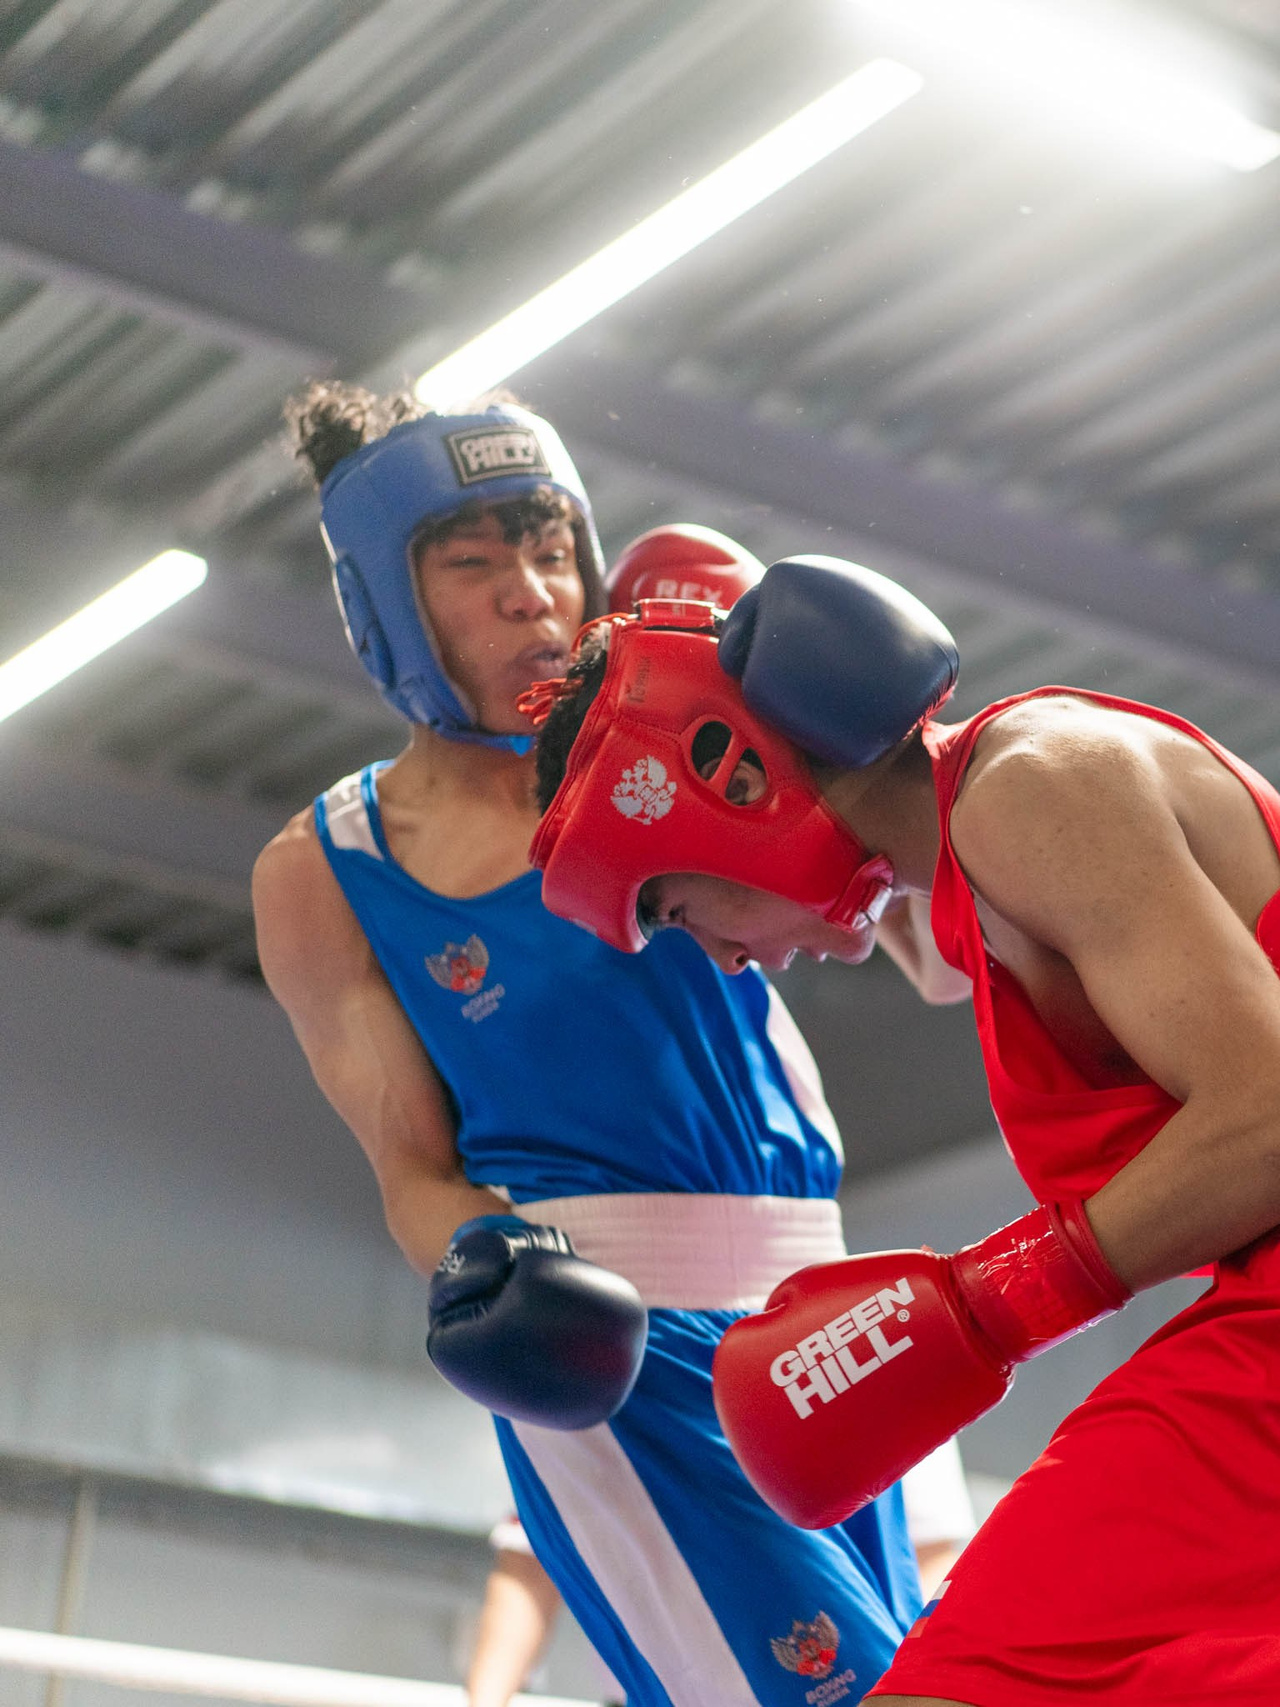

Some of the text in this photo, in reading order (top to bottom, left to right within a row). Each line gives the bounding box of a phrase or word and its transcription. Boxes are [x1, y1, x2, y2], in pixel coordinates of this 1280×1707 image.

[655, 578, 724, 609] REX
[769, 1277, 916, 1387] GREEN
[783, 1325, 914, 1420] HILL
